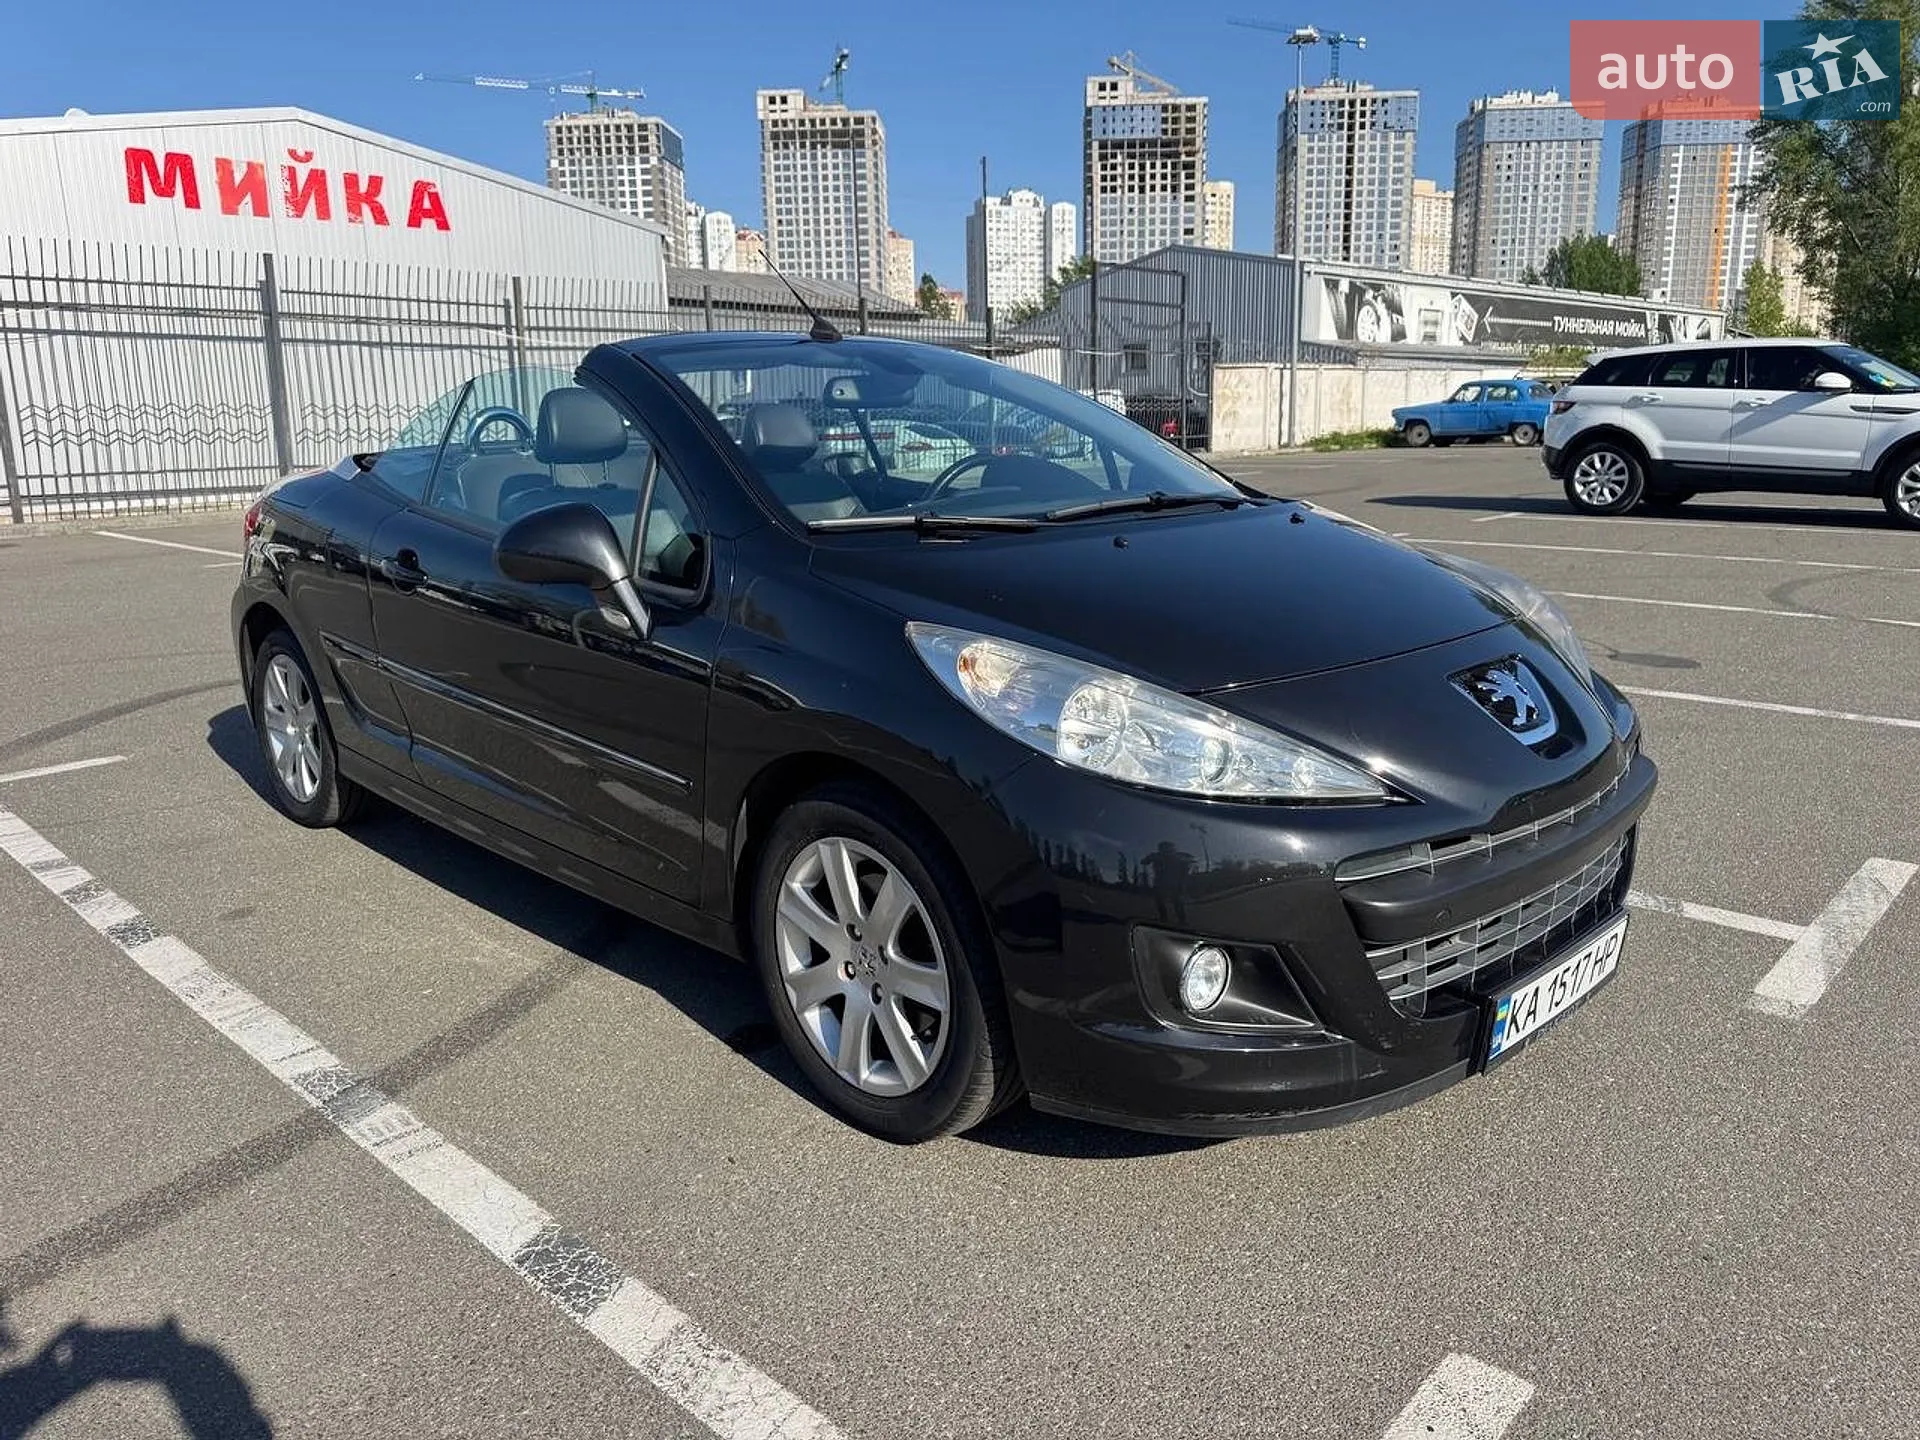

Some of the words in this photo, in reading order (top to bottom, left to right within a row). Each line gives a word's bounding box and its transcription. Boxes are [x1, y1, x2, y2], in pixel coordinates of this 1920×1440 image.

[124, 147, 451, 231] МИЙКА
[1553, 316, 1614, 336] ТУННЕЛЬНАЯ
[1615, 319, 1646, 338] МОЙКА
[1506, 986, 1539, 1041] KA
[1548, 951, 1592, 1013] 1517
[1589, 932, 1619, 984] HP
